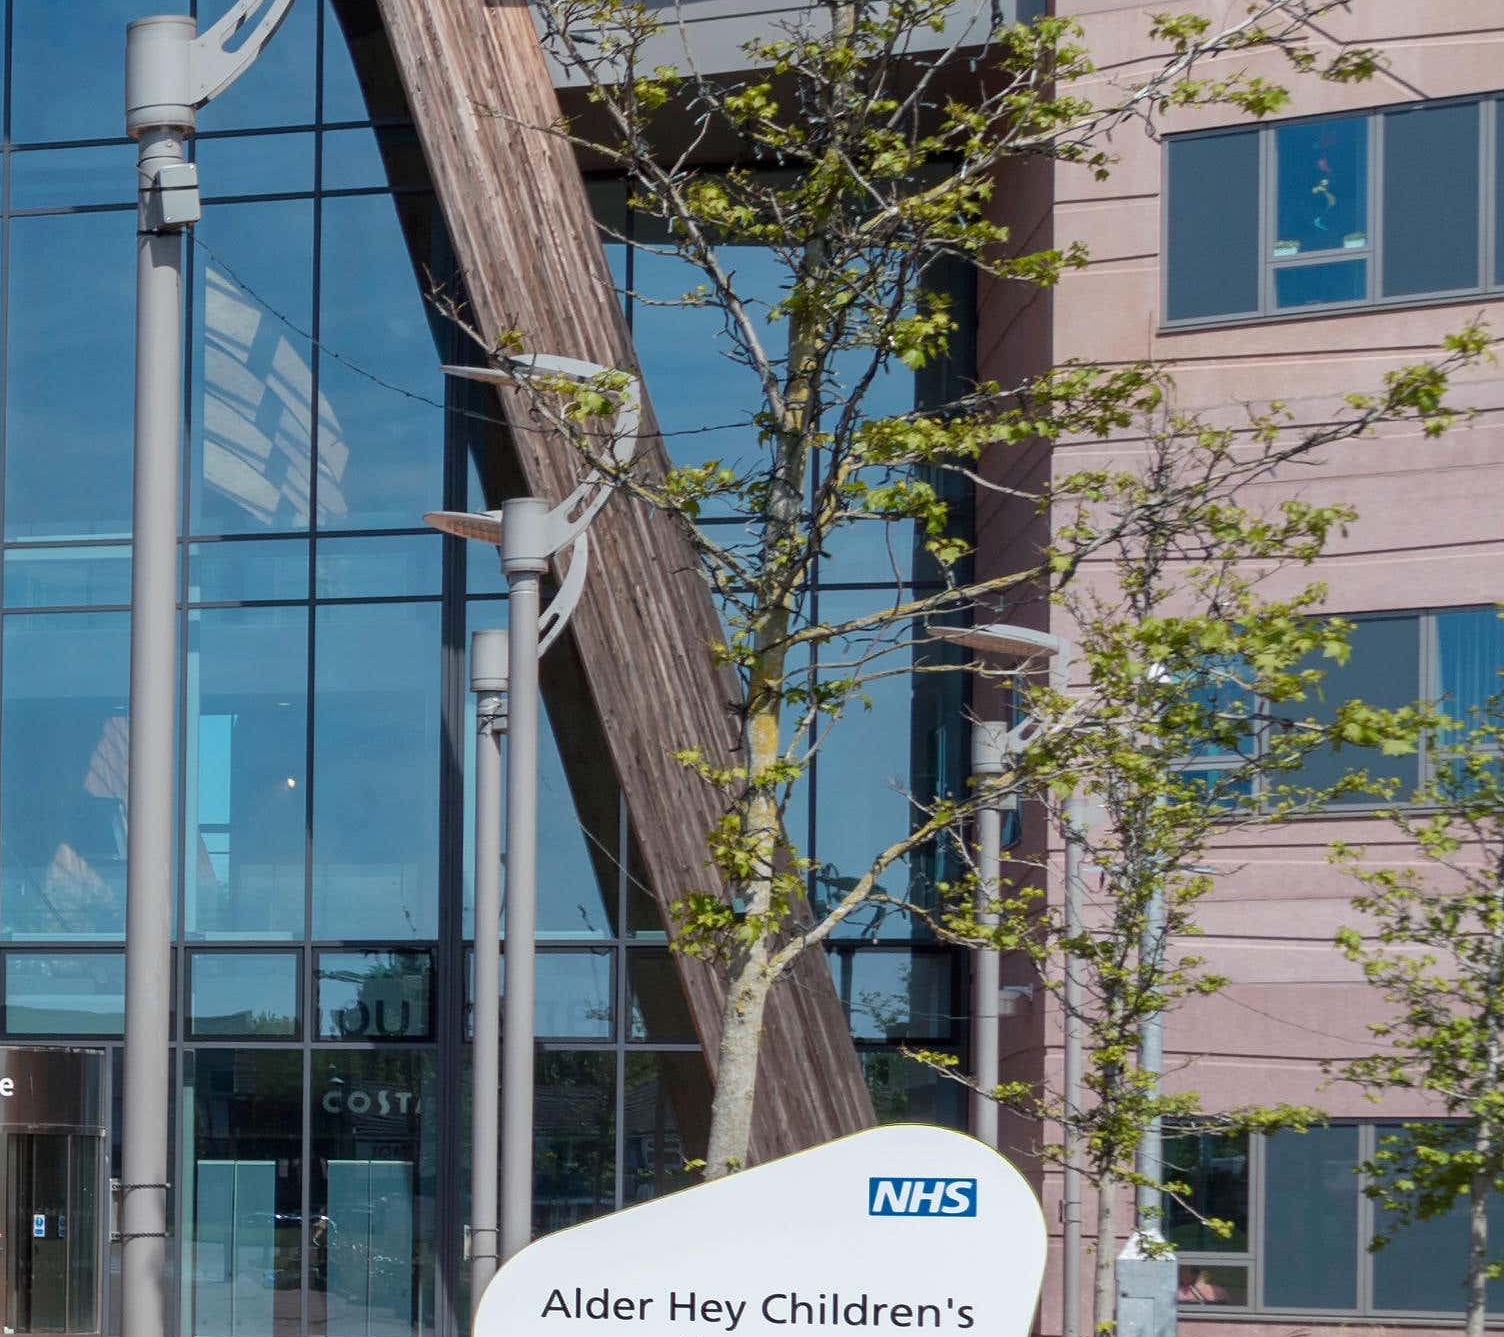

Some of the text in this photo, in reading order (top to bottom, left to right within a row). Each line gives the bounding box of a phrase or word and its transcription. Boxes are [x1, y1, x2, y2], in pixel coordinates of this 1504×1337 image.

[871, 1180, 973, 1215] NHS
[540, 1286, 975, 1331] Alder Hey Children's
